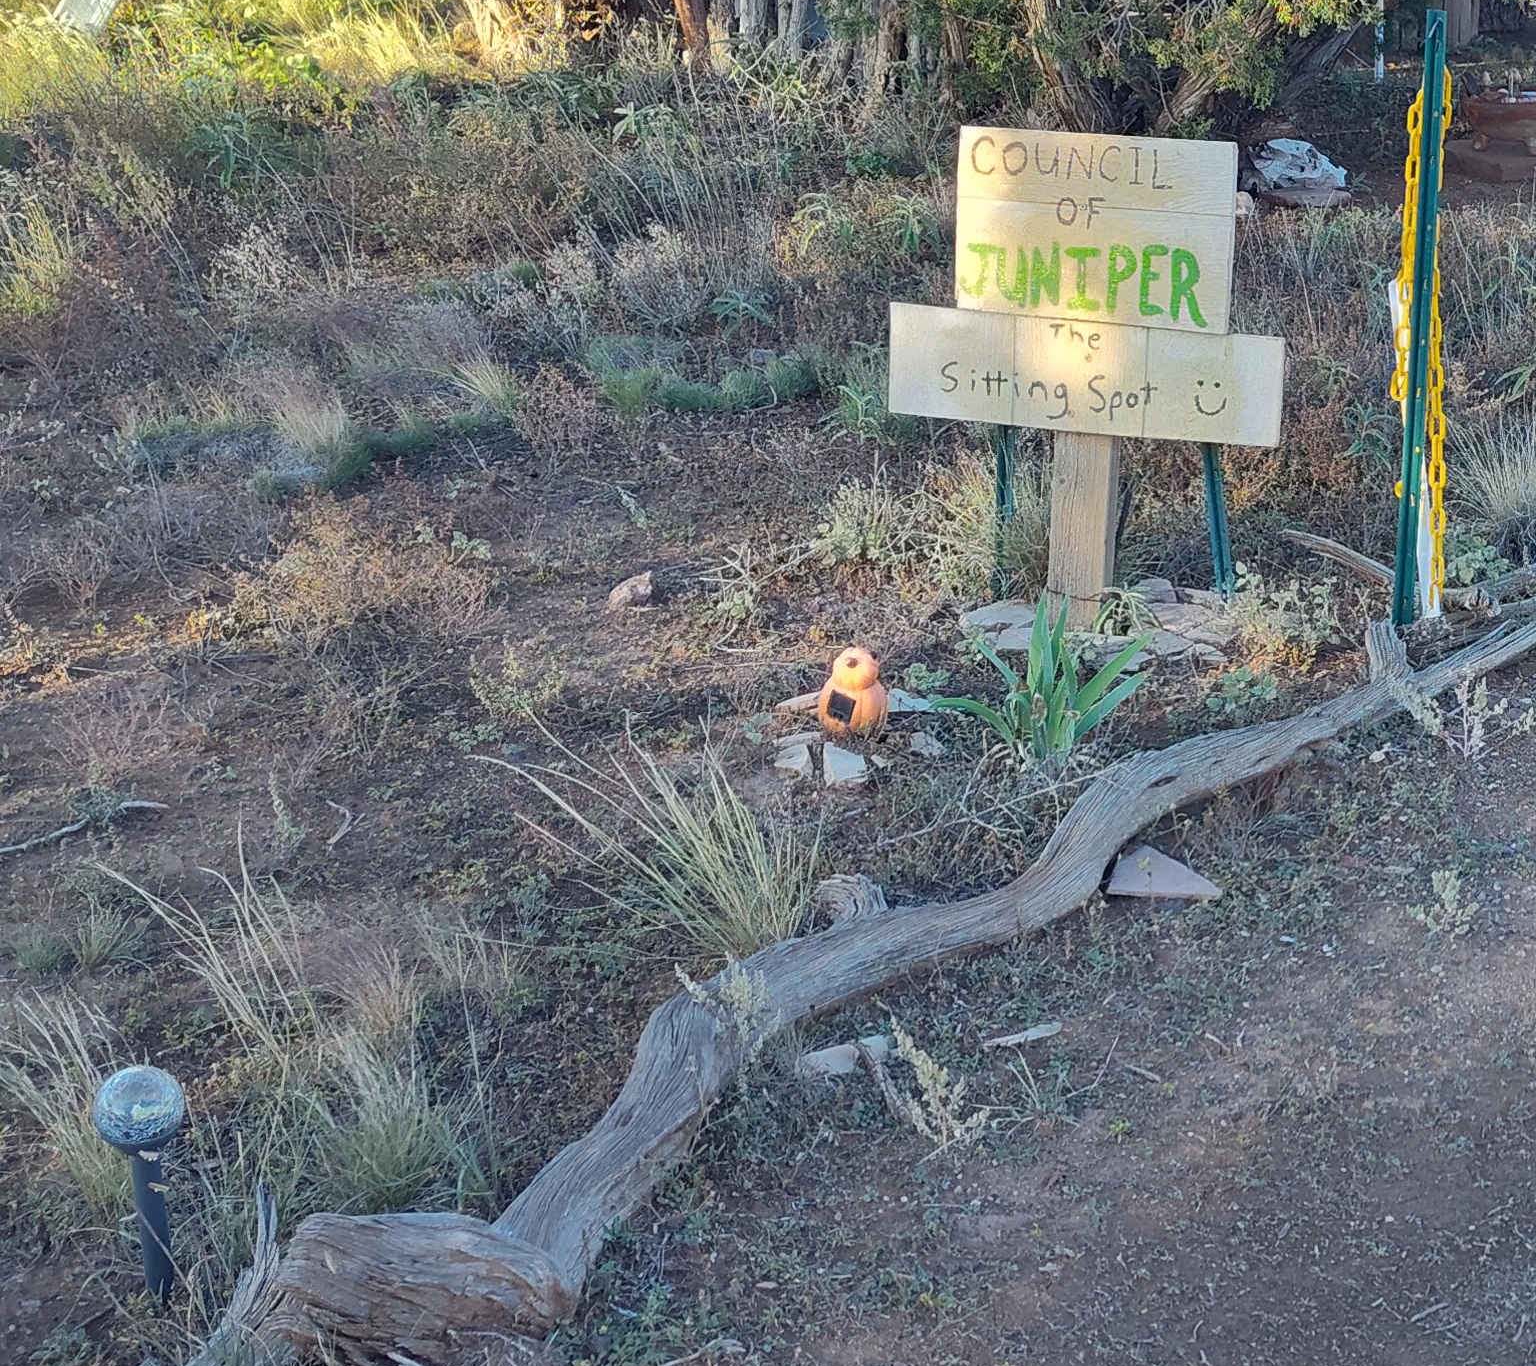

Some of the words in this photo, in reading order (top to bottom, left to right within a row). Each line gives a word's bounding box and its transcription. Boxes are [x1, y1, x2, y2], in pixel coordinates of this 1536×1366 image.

[971, 135, 1174, 190] COUNCIL
[1056, 196, 1106, 230] OF
[959, 240, 1208, 328] JUNIPER
[1049, 323, 1101, 351] The
[940, 361, 1071, 420] Sitting
[1088, 374, 1159, 421] Spot
